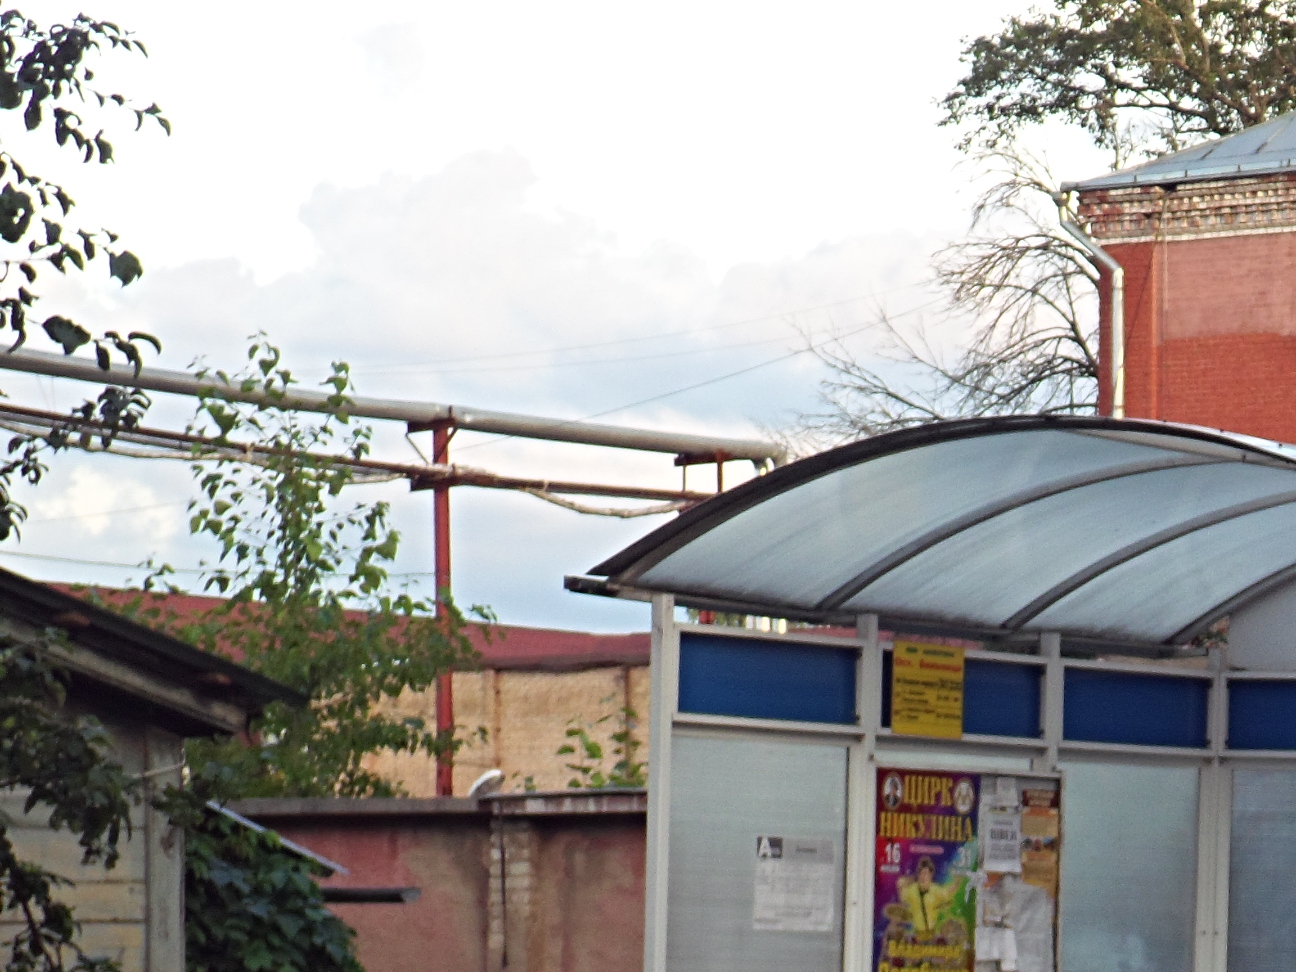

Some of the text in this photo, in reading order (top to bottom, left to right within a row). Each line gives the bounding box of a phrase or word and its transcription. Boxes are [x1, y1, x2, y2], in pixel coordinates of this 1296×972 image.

[903, 775, 953, 809] ЦИРК
[879, 811, 973, 842] НИКУЛИНА
[885, 842, 901, 863] 16
